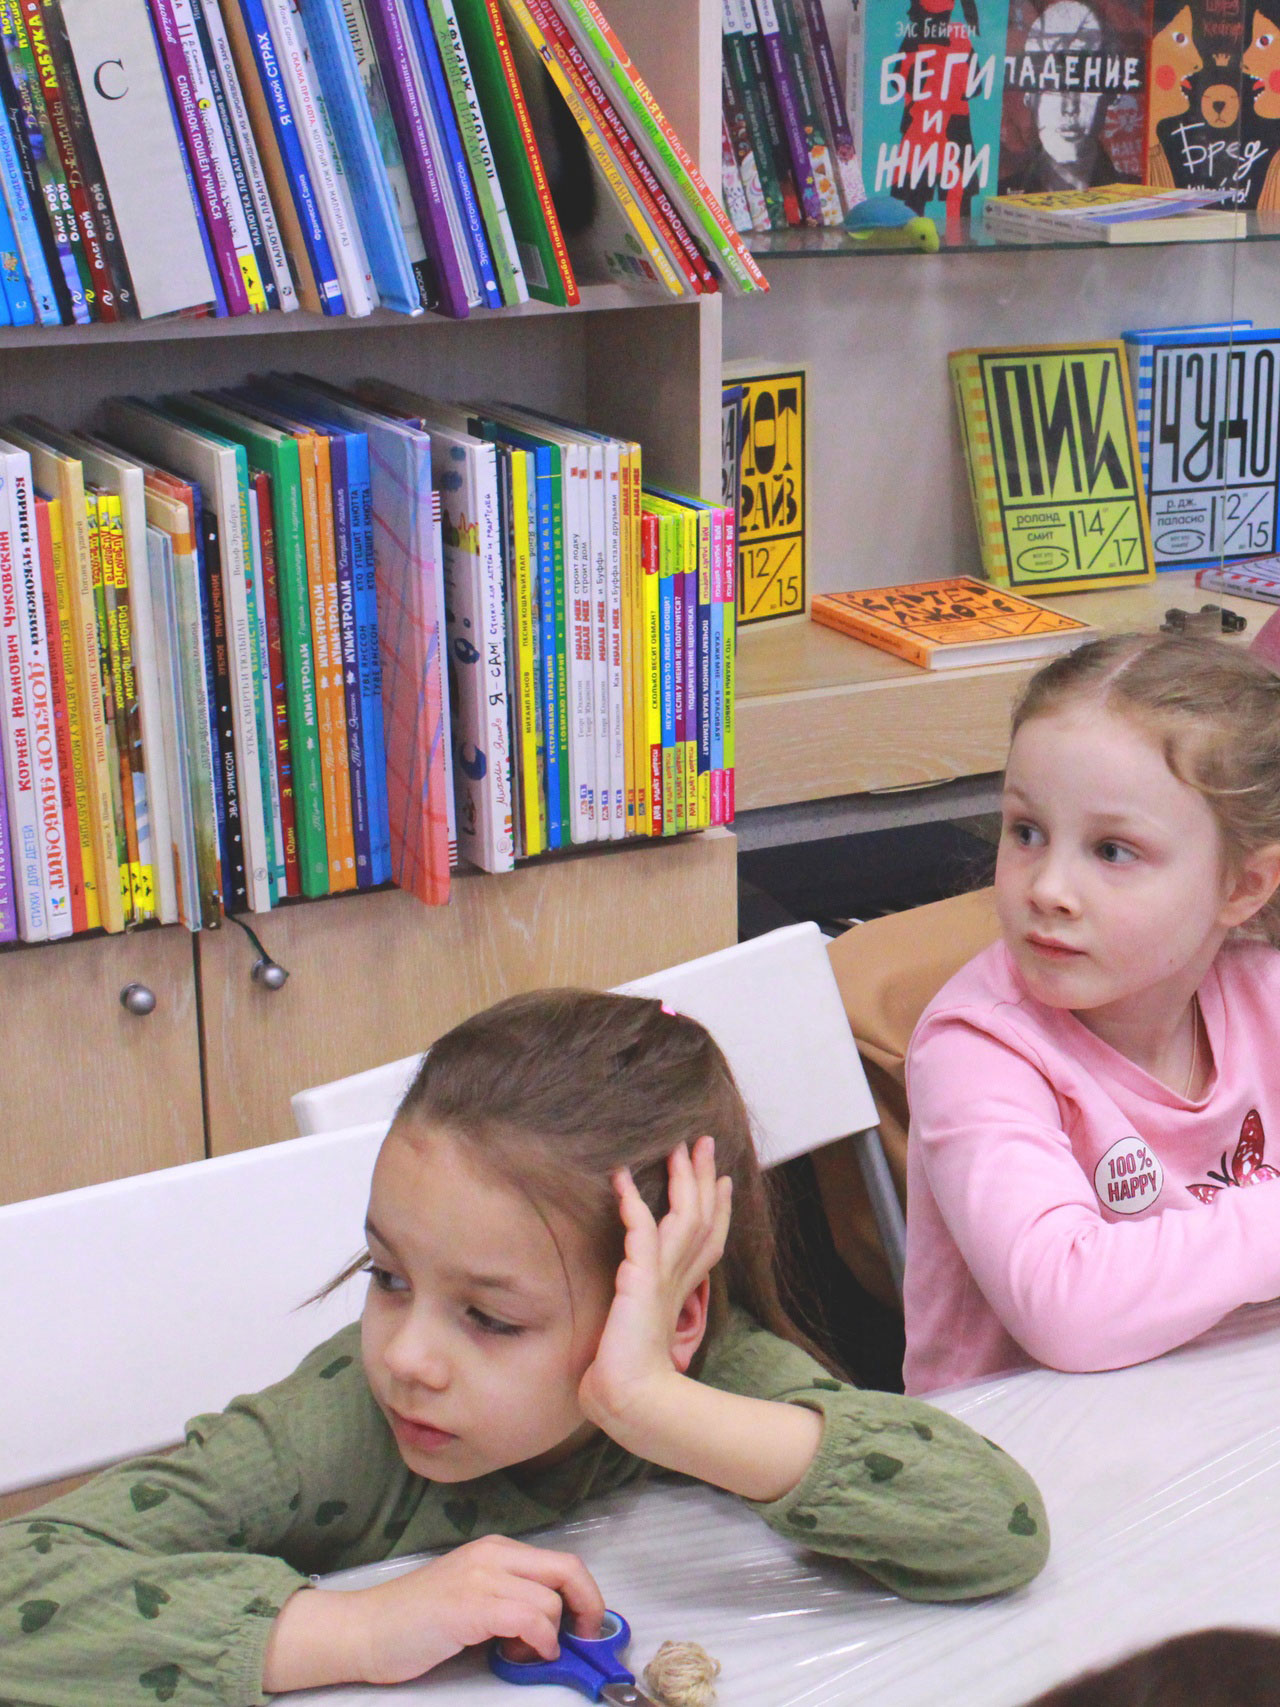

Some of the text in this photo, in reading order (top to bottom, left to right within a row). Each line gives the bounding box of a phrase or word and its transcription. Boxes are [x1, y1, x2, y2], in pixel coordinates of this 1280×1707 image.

[486, 0, 506, 38] Ричард
[895, 20, 918, 38] ЭЛС
[26, 13, 60, 90] АЗБУКА
[215, 36, 230, 62] ЗАМКА
[255, 30, 280, 78] СТРАХ
[289, 50, 306, 84] СКАЗКА
[221, 63, 245, 119] КОРОЛЕВСКОГО
[298, 84, 311, 103] ПРО
[395, 57, 422, 117] ВОЛШЕБНИКА
[500, 48, 523, 101] поведении
[879, 49, 996, 105] БЕГИ
[1004, 53, 1140, 91] ПАДЕНИЕ
[172, 73, 202, 133] СЛОНЁНОК
[440, 31, 482, 166] ЖИВЫЕ СПИРАЛИ
[446, 16, 495, 179] ПОЛТОРА ЖИРАФА
[279, 113, 292, 126] Я
[411, 117, 431, 157] КНИЖКА
[515, 103, 535, 143] хорошем
[189, 130, 213, 171] ПОШЁЛ
[240, 130, 261, 179] ПРИВИДЕНИЕ
[309, 128, 329, 168] КОТОРЫЙ
[632, 77, 736, 237] ШМЯК: СЛАСТИ ИЛИ НАПАСТИ
[874, 141, 991, 193] ЖИВИ
[321, 168, 334, 189] ЖИЛ
[421, 157, 444, 204] ЗАПИСНАЯ
[529, 155, 547, 191] Книжка
[199, 171, 224, 221] УЧИТЬСЯ
[252, 180, 271, 216] ЛАБАН
[295, 172, 324, 241] Франческа Санна
[326, 188, 346, 231] МИЛЛИОН
[338, 230, 350, 247] РАЗ
[539, 190, 565, 249] пожалуйста.
[261, 215, 286, 268] МАЛЮТКА
[557, 258, 577, 297] Спасибо
[991, 359, 1129, 499] ПИК
[1159, 348, 1275, 484] ЧУДО
[1016, 512, 1061, 527] роланд
[1027, 531, 1054, 542] смит
[1078, 509, 1105, 537] 14
[1157, 513, 1205, 527] паласио
[1246, 521, 1269, 549] 15
[1112, 537, 1138, 567] 17
[208, 572, 225, 637] ПРИКЛЮЧЕНИЕ
[776, 576, 798, 608] 15
[99, 529, 125, 710] Лизелотта ночной переполох
[109, 531, 136, 700] Лизелотта развозит подарки
[339, 580, 357, 663] МУМИ-ТРОЛЛИ
[673, 594, 683, 646] ПОЛУЧИТСЯ?
[518, 553, 533, 734] МИХАИЛ ЯСНОВ ПЕСНИ КОШАЧЬИХ ЛАП
[648, 609, 659, 710] СКОЛЬКО ВЕСИТ ОБМАН?
[661, 594, 673, 731] НЕУЖЕЛИ КТО-ТО ЛЮБИТ ОВОЩИ?
[685, 603, 696, 711] ПОДАРИТЕ МНЕ ЩЕНОЧКА!
[712, 630, 721, 660] СКАЖИ
[723, 636, 731, 654] ЧТО
[545, 653, 555, 701] ПРАЗДНИК
[555, 651, 567, 696] ГЕРБАРИЙ
[674, 659, 683, 683] МЕНЯ
[700, 618, 711, 757] ПОЧЕМУ ТЕМНОТА ТАКАЯ ТЁМНАЯ?
[712, 660, 721, 680] МНЕ
[722, 664, 731, 690] МАМЫ
[558, 697, 568, 742] СОБИРАЮ
[675, 693, 683, 713] ЕСЛИ
[712, 696, 722, 742] КРАСИВАЯ?
[722, 697, 732, 734] ЖИВОТЕ?
[546, 701, 557, 756] УСТРАИВАЮ
[224, 751, 238, 795] ЭРИКСОН
[228, 798, 239, 818] ЭВА
[21, 824, 37, 860] ДЕТЕЙ
[26, 863, 40, 887] ДЛЯ
[29, 890, 43, 928] СТИХИ
[1107, 1169, 1158, 1203] HAPPY
